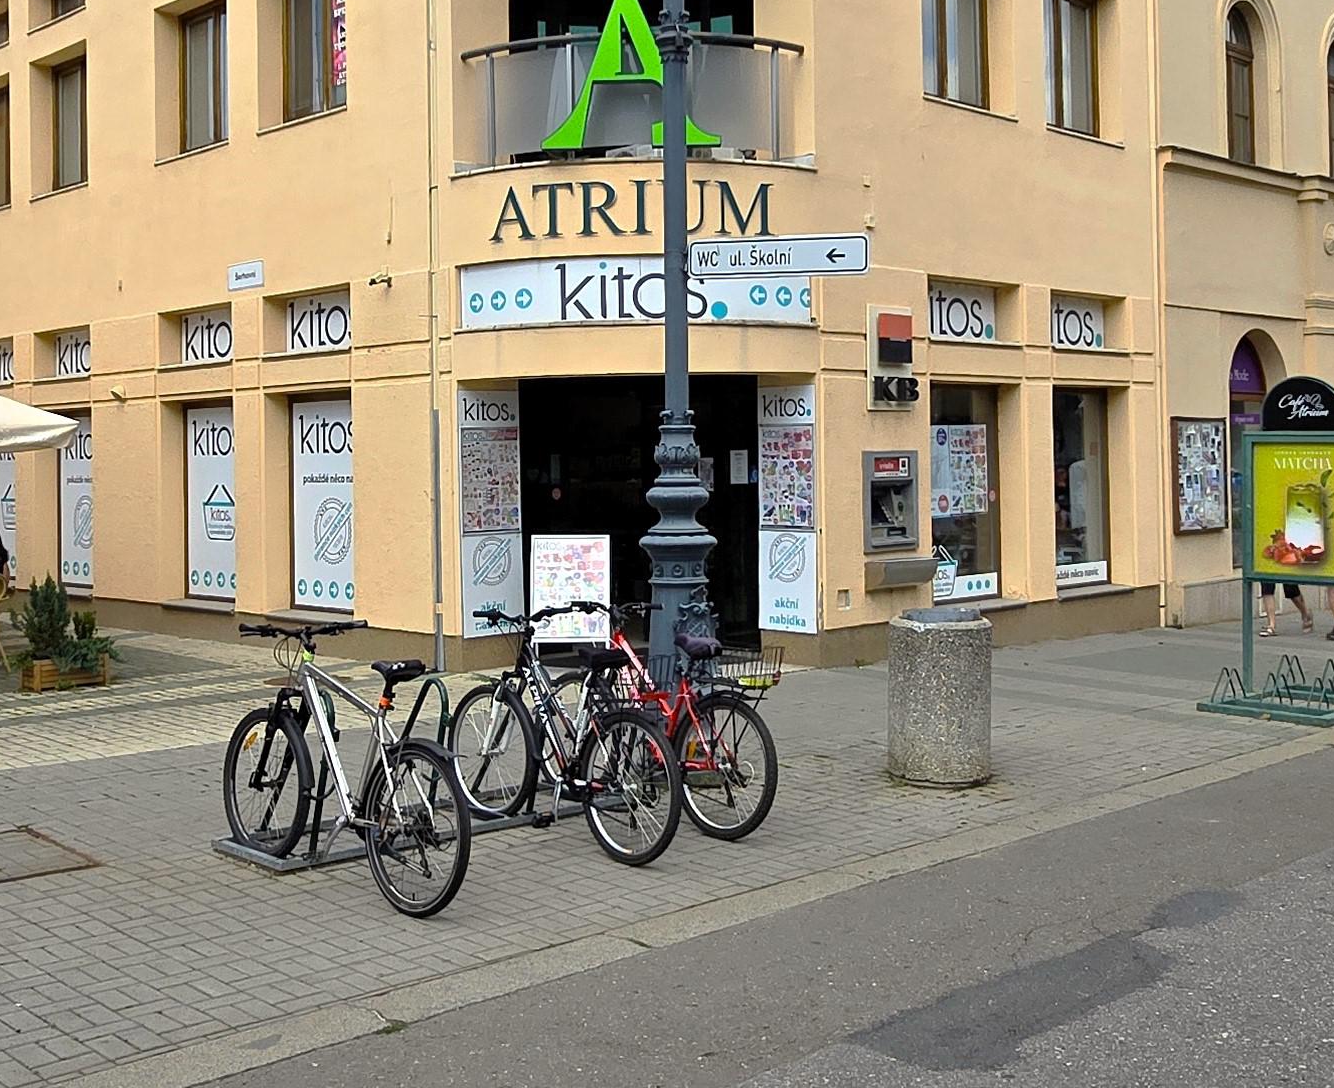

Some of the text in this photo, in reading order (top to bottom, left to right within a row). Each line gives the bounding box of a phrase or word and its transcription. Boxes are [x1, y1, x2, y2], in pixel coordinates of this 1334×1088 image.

[697, 245, 793, 267] WC ul. Školní
[288, 299, 352, 350] kito
[873, 376, 920, 402] KB
[1286, 405, 1330, 420] Atrium
[192, 420, 235, 456] kito
[1274, 457, 1332, 470] MATCHA
[774, 597, 799, 609] akční
[769, 613, 807, 627] nabídka
